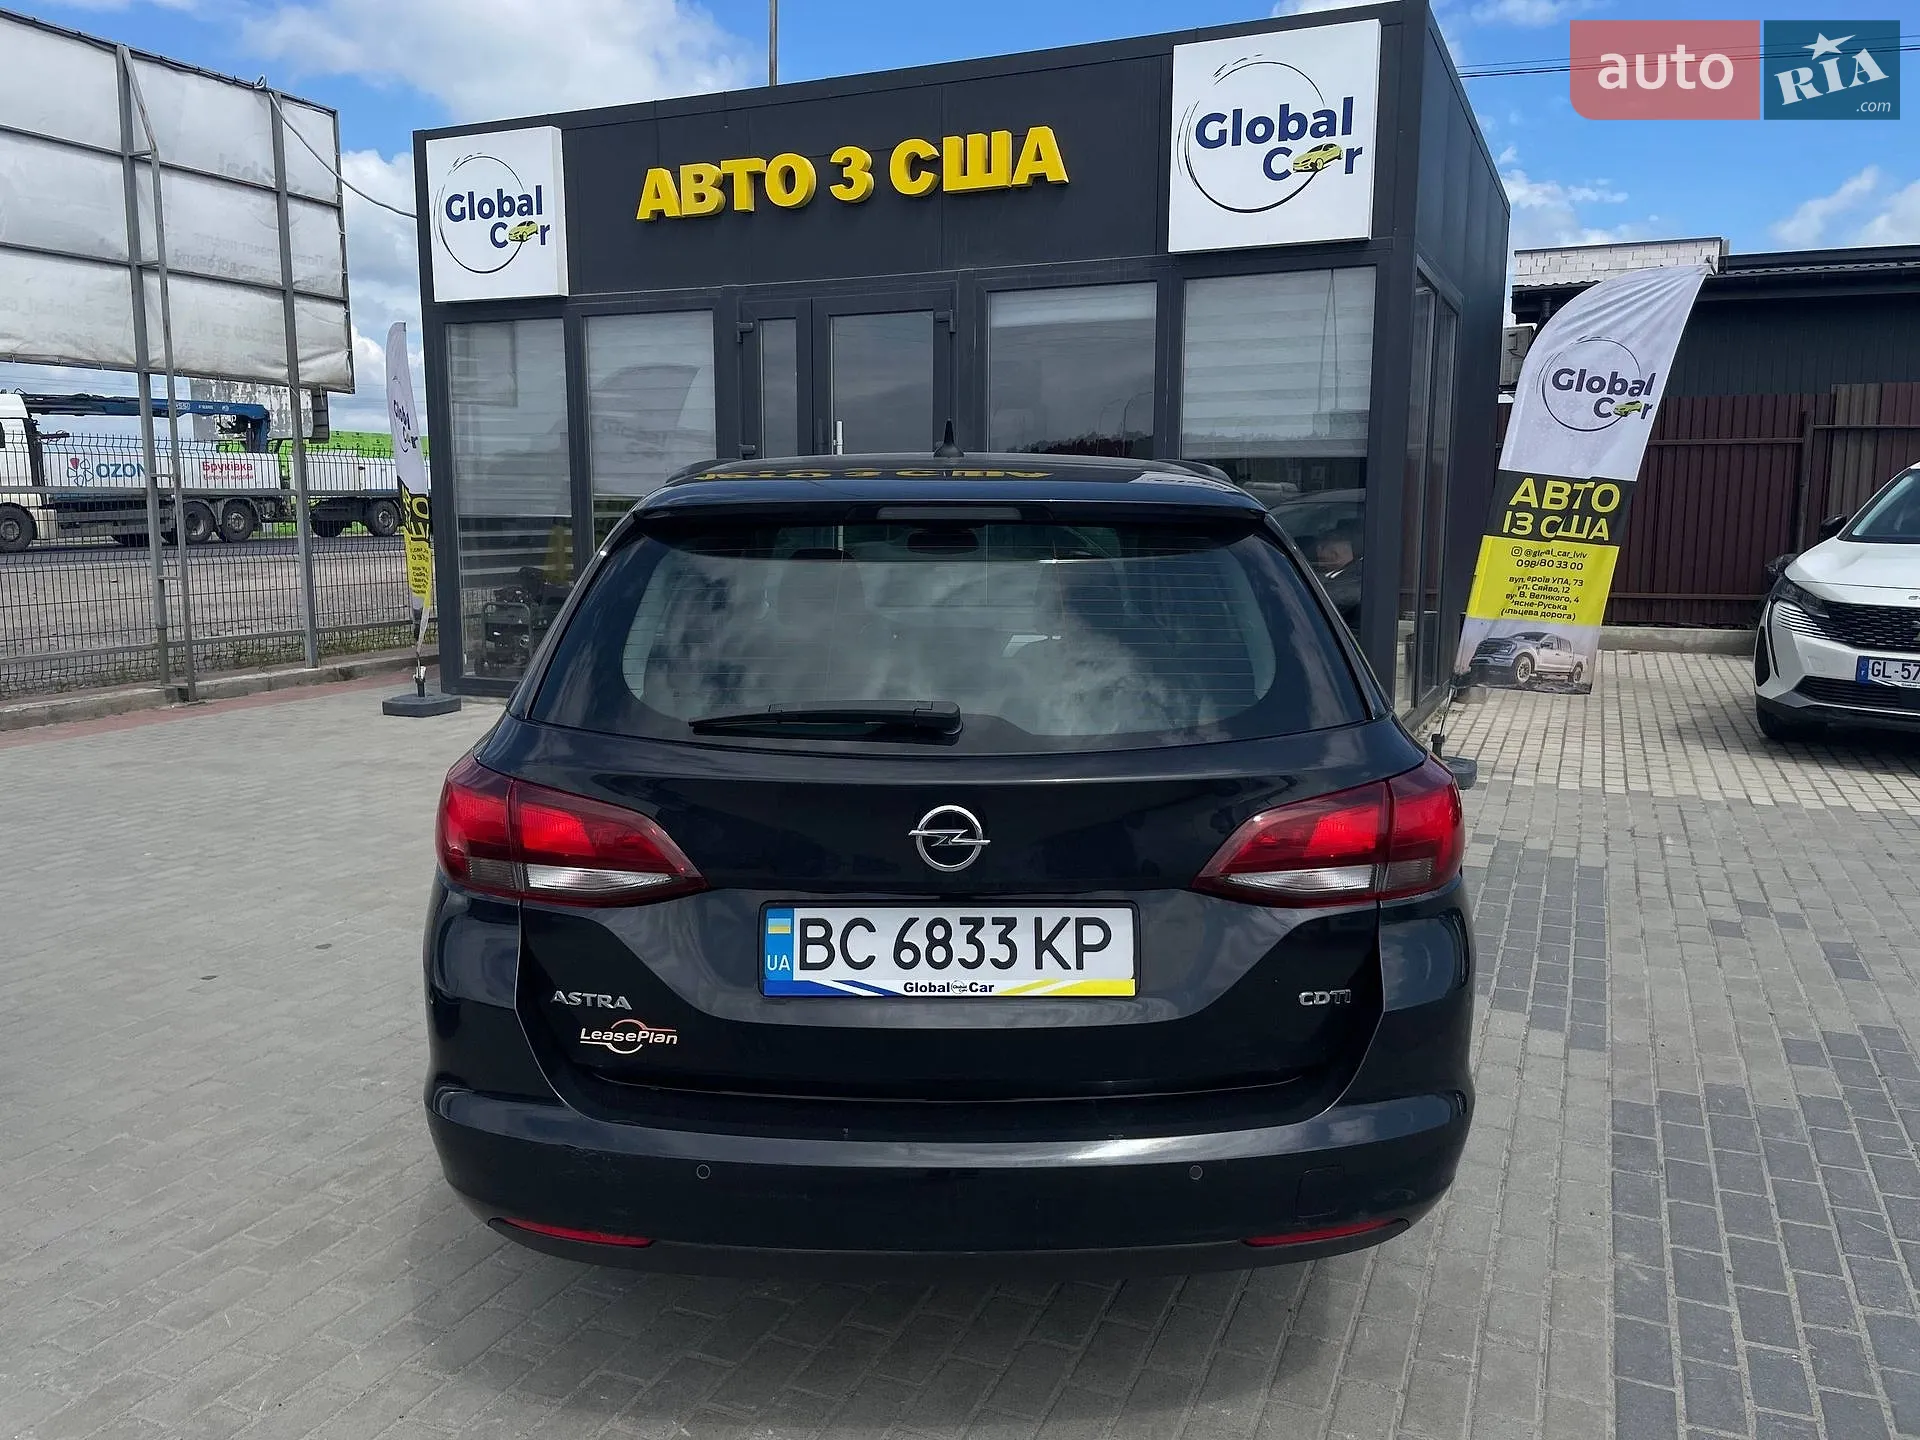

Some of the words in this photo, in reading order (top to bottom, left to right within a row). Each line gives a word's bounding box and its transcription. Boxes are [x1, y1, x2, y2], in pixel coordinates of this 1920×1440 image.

[1195, 96, 1354, 149] Global
[636, 152, 817, 221] АВТО
[829, 146, 874, 204] З
[889, 126, 1069, 199] США
[1262, 146, 1364, 181] Cr
[445, 185, 543, 223] Global
[489, 221, 551, 249] Cr
[1551, 367, 1657, 397] Global
[1593, 396, 1654, 420] Cr
[1508, 477, 1620, 513] АВТО
[1540, 514, 1609, 541] США
[1526, 575, 1550, 584] ероїв
[1573, 578, 1584, 587] 73
[1511, 599, 1568, 611] ясне-Руська
[893, 916, 1018, 971] 6833
[766, 954, 791, 972] UA
[550, 990, 633, 1011] ASTRA
[903, 982, 950, 993] Global
[968, 982, 994, 993] Car
[580, 1027, 678, 1045] LeasePlan
